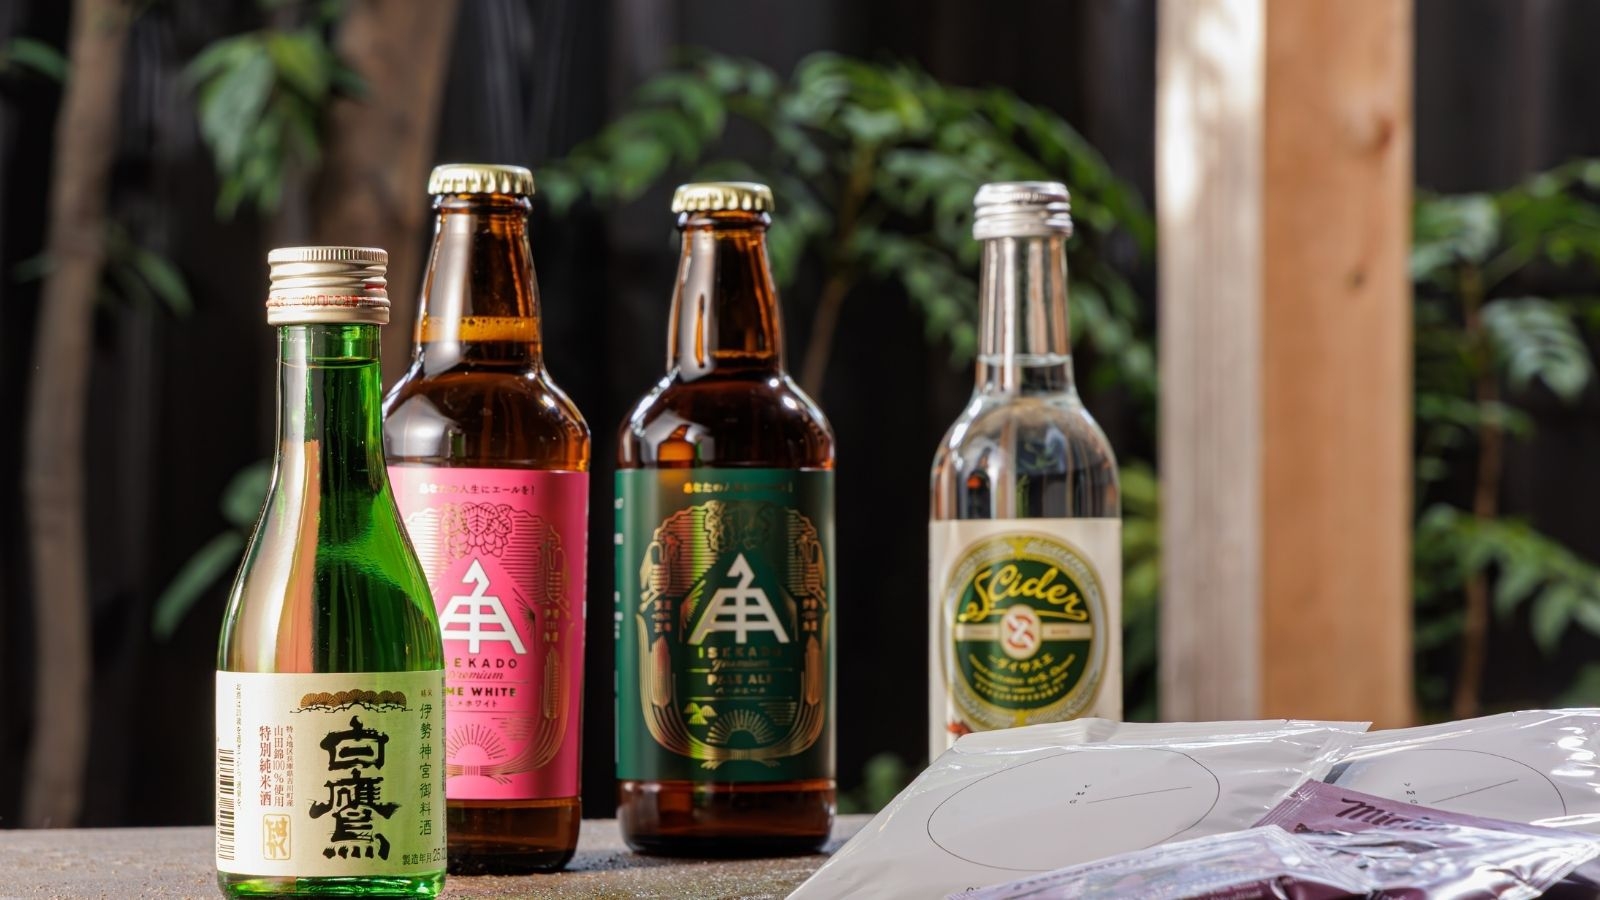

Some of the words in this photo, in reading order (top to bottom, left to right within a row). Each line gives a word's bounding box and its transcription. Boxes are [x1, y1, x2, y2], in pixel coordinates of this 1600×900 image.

[471, 687, 518, 697] WHITE
[259, 725, 272, 807] 特別純米酒
[309, 715, 402, 861] 白鷹
[419, 703, 433, 836] 伊勢神宮御料酒
[402, 852, 432, 866] 製造年月
